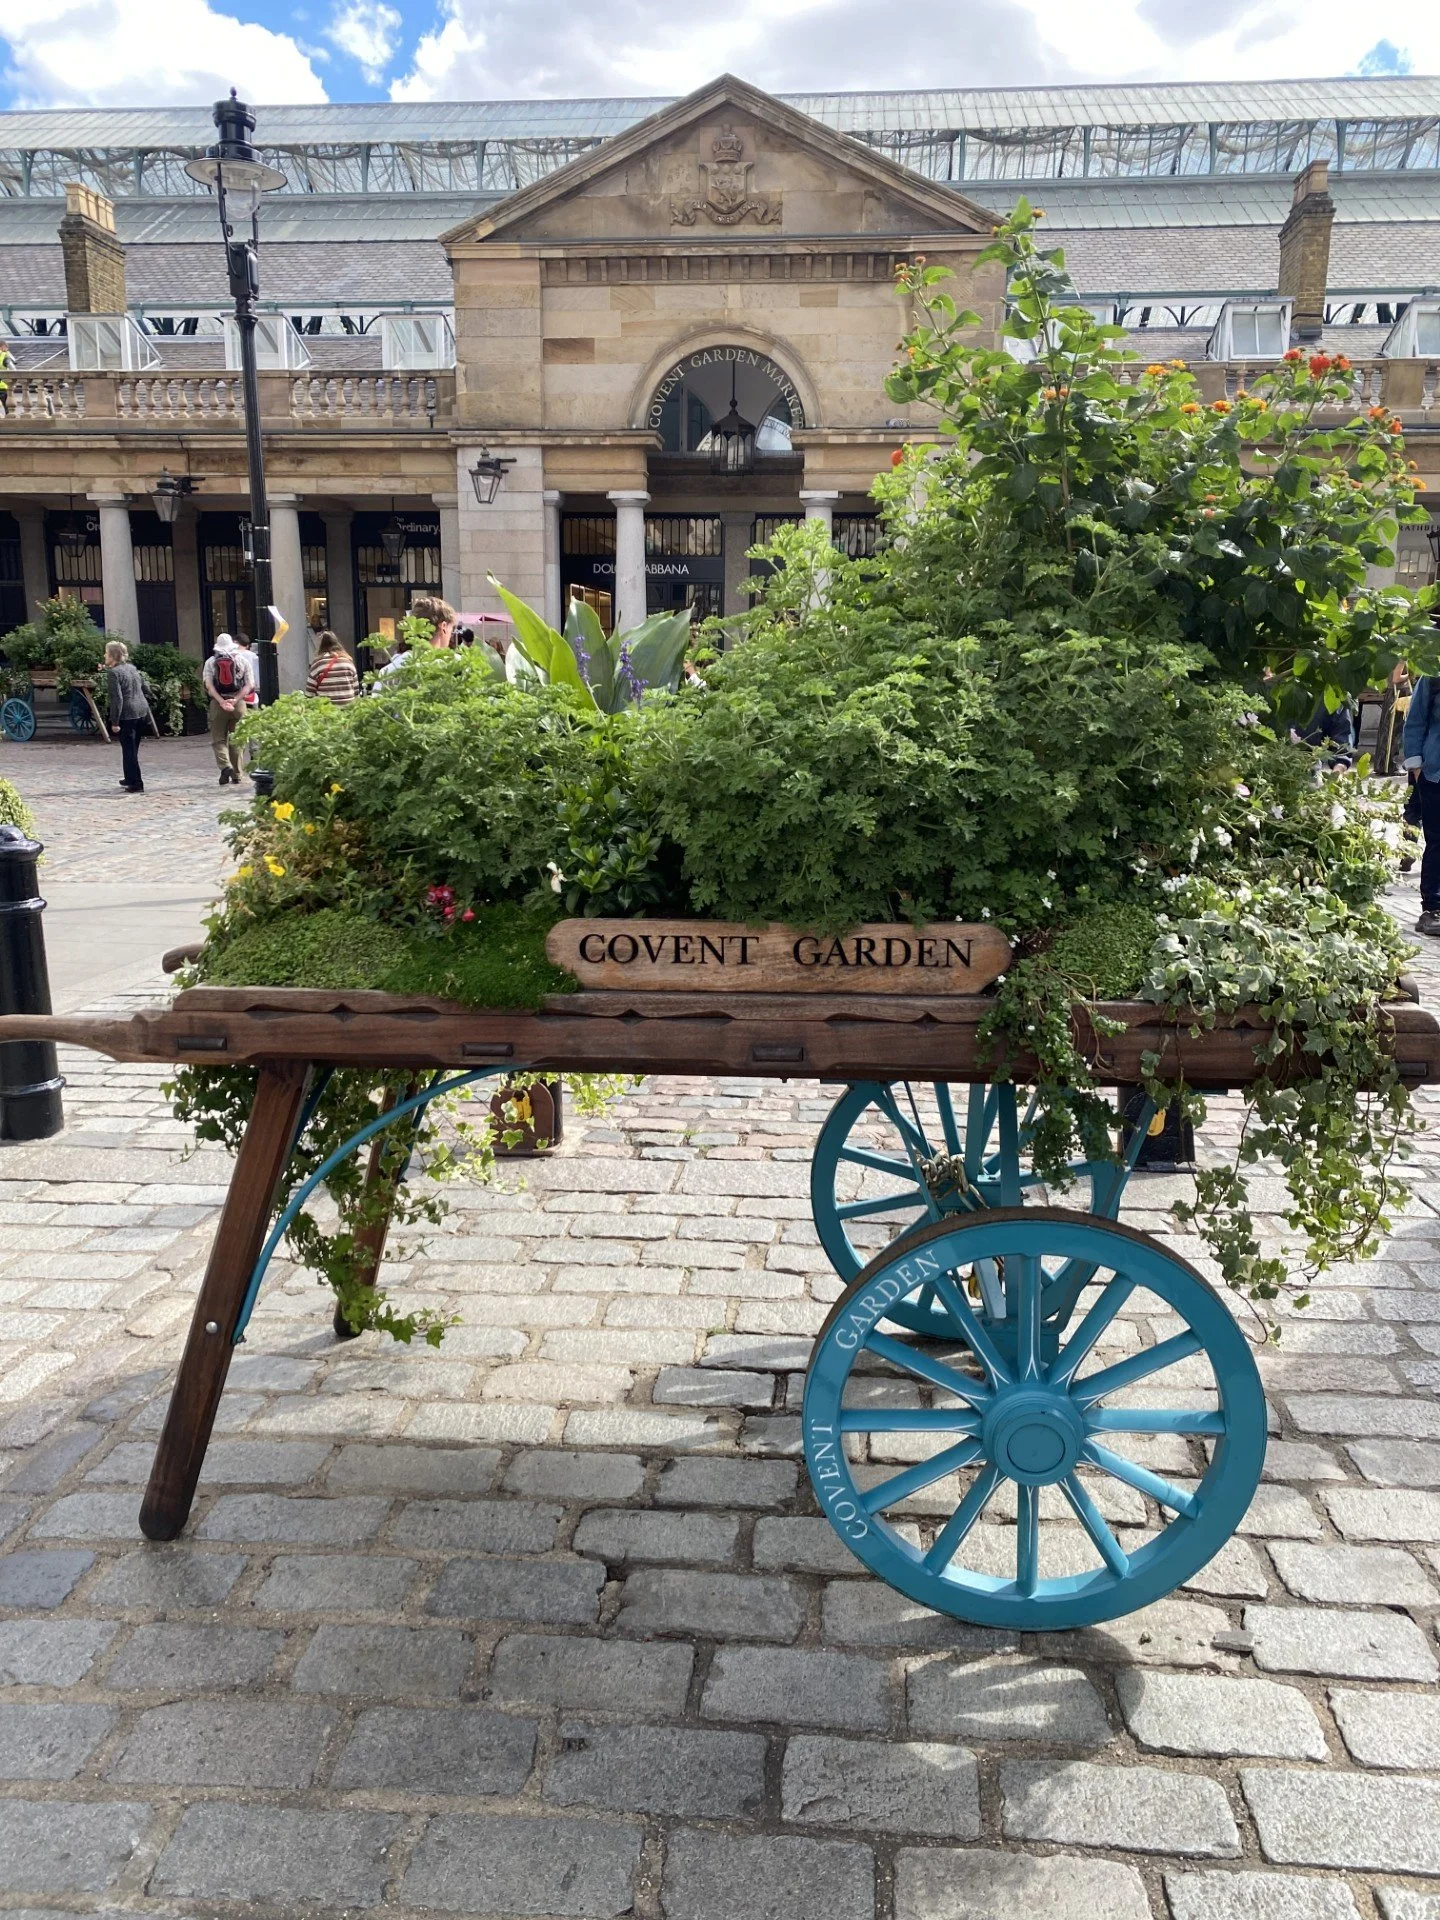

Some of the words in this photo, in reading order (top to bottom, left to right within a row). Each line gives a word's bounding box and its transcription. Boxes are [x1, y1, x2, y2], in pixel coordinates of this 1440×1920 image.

[650, 364, 686, 428] COVENT
[690, 348, 760, 368] GARDEN
[762, 361, 805, 429] MARKET
[593, 563, 617, 574] DOL
[644, 563, 690, 575] ABBANA
[579, 933, 760, 966] COVENT
[793, 935, 974, 969] GARDEN
[835, 1249, 943, 1350] GARDEN
[811, 1418, 868, 1539] COVENT
